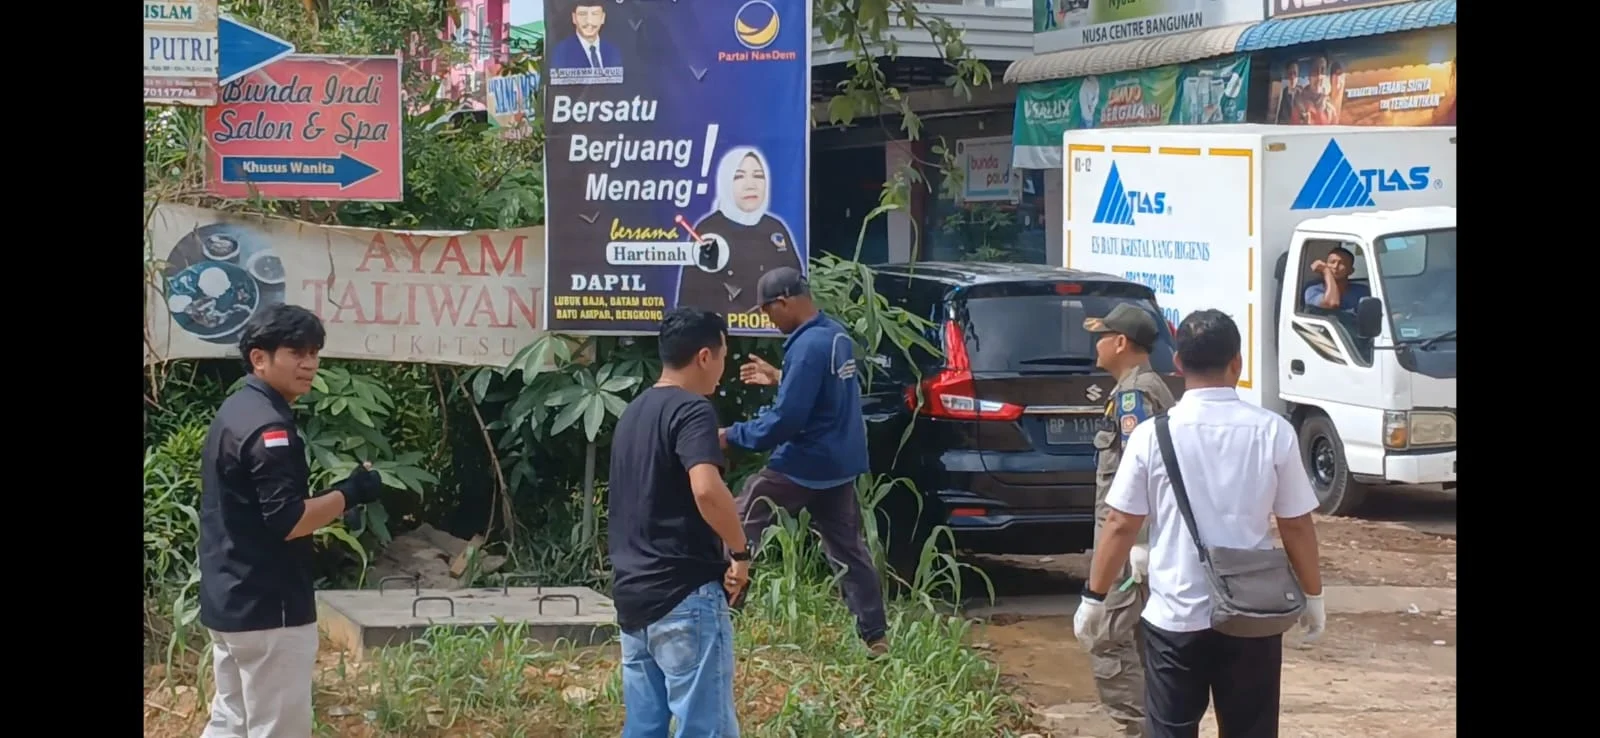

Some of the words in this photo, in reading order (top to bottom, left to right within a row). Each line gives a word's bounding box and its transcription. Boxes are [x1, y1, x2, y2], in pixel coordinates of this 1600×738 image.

[144, 4, 192, 19] ISLAM
[1082, 29, 1107, 43] NUSA
[1109, 21, 1144, 40] CENTRE
[1146, 12, 1203, 34] BANGUNAN
[149, 37, 212, 61] PUTRI
[718, 51, 749, 61] Partai
[222, 75, 312, 104] Bunda
[321, 74, 383, 105] Indi
[552, 95, 658, 123] Bersatu
[214, 109, 292, 142] Salon
[302, 111, 325, 140] &
[334, 111, 389, 149] Spa
[568, 134, 693, 169] Berjuang
[971, 154, 998, 169] bunda
[242, 160, 287, 174] Khusus
[290, 161, 335, 175] Wanita
[585, 173, 693, 208] Menang
[609, 218, 680, 241] bersama
[355, 231, 528, 277] AYAM
[613, 246, 687, 262] Hartinah
[1091, 236, 1100, 254] ES
[1101, 237, 1119, 255] BATU
[1152, 240, 1173, 259] YANG
[571, 274, 646, 291] DAPIL
[302, 279, 543, 330] TALIWAN
[554, 296, 581, 306] LUBUK
[583, 296, 608, 308] BAJA,
[610, 296, 640, 306] BATAM
[642, 296, 665, 307] KOTA
[556, 310, 577, 319] BATU
[580, 310, 614, 320] AMPAR,
[616, 310, 664, 321] BENGKONG
[727, 313, 776, 328] PROP
[1050, 418, 1064, 433] BP
